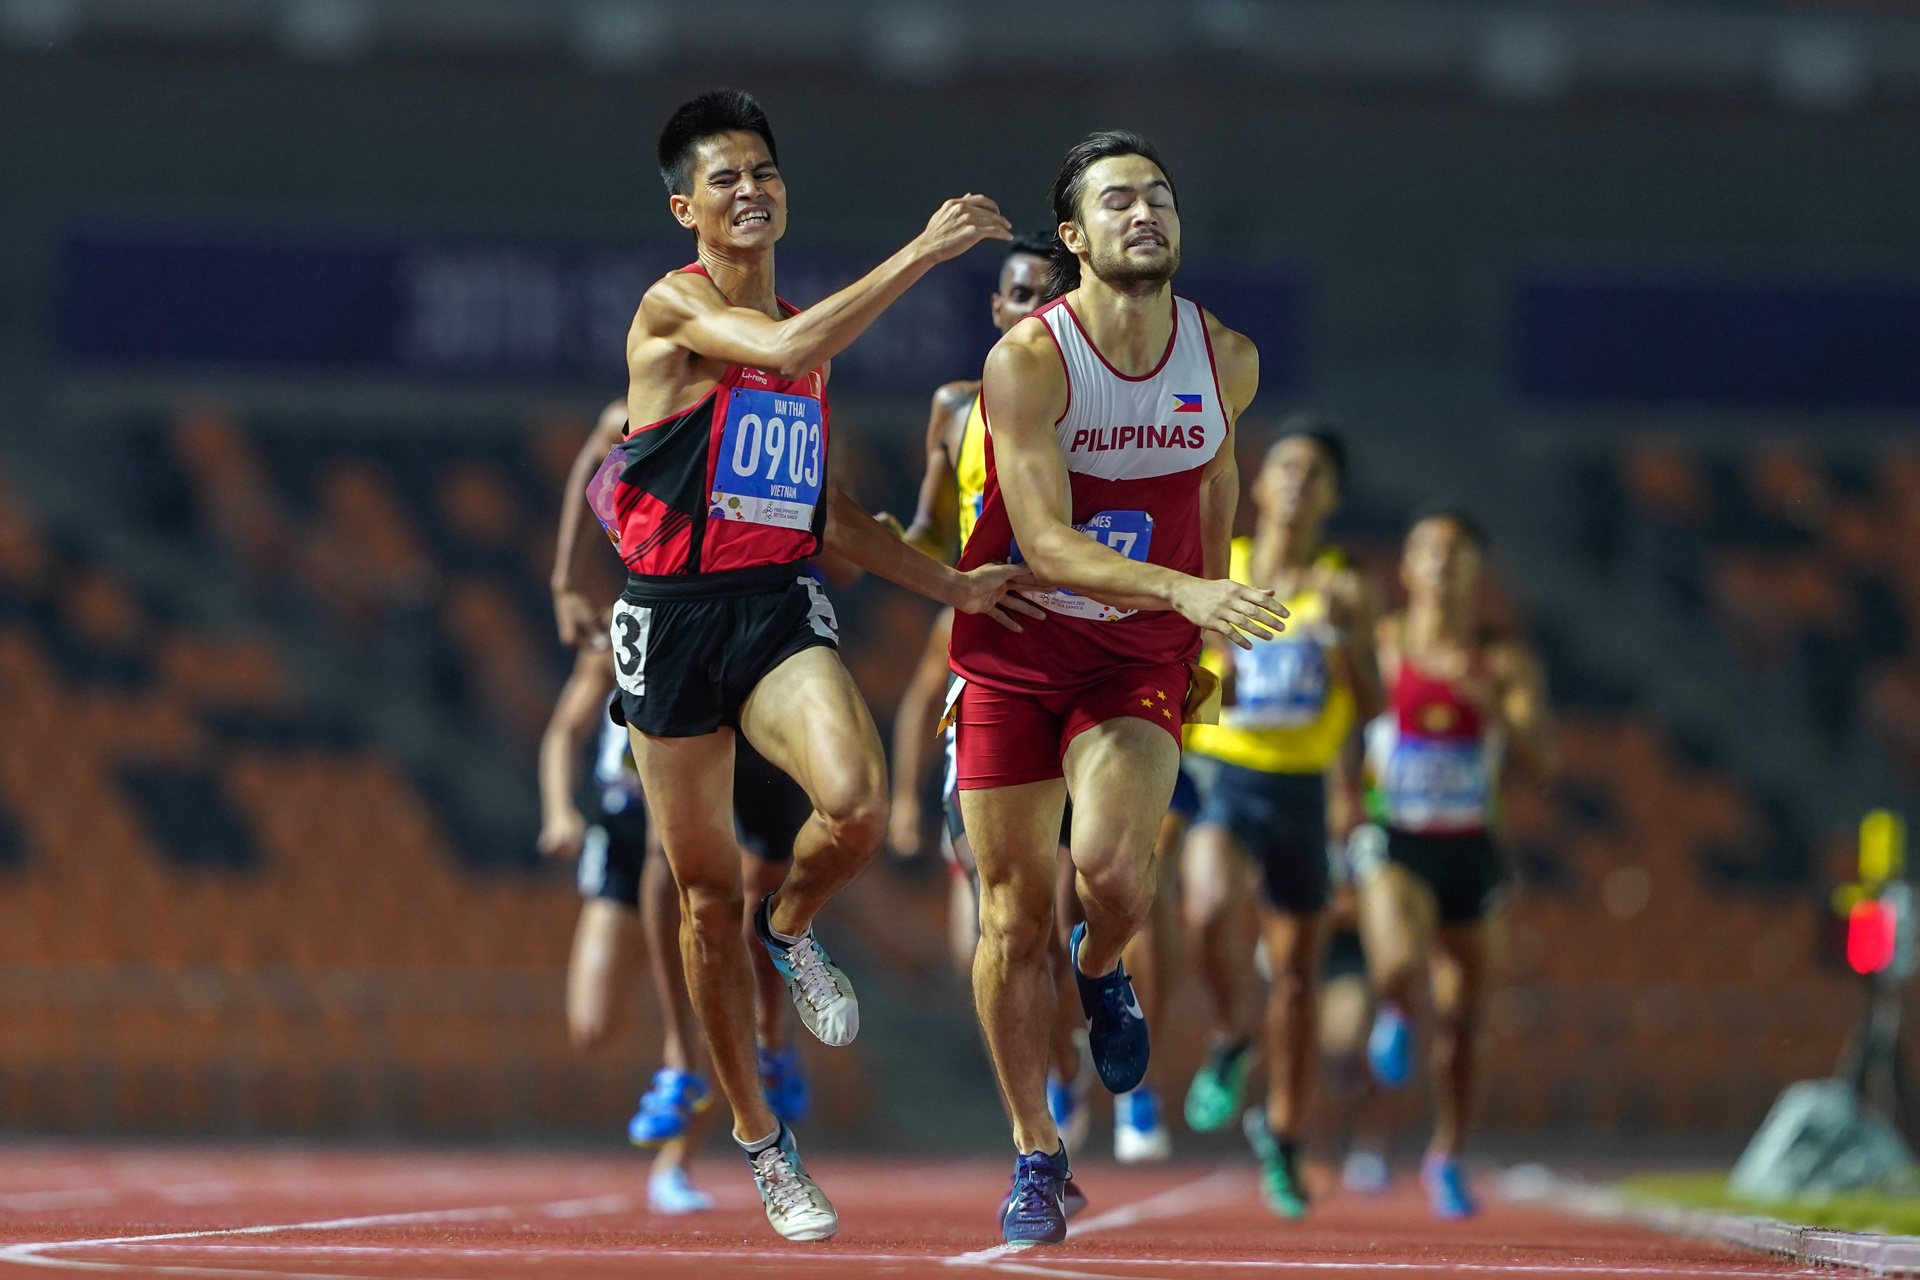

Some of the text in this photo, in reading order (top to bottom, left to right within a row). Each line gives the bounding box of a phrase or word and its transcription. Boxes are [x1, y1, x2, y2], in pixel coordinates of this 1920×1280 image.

[774, 399, 806, 418] VAN THAI
[732, 413, 820, 488] 0903
[1070, 425, 1205, 453] PILIPINAS
[770, 484, 796, 499] VIETNAM
[615, 611, 642, 677] 3
